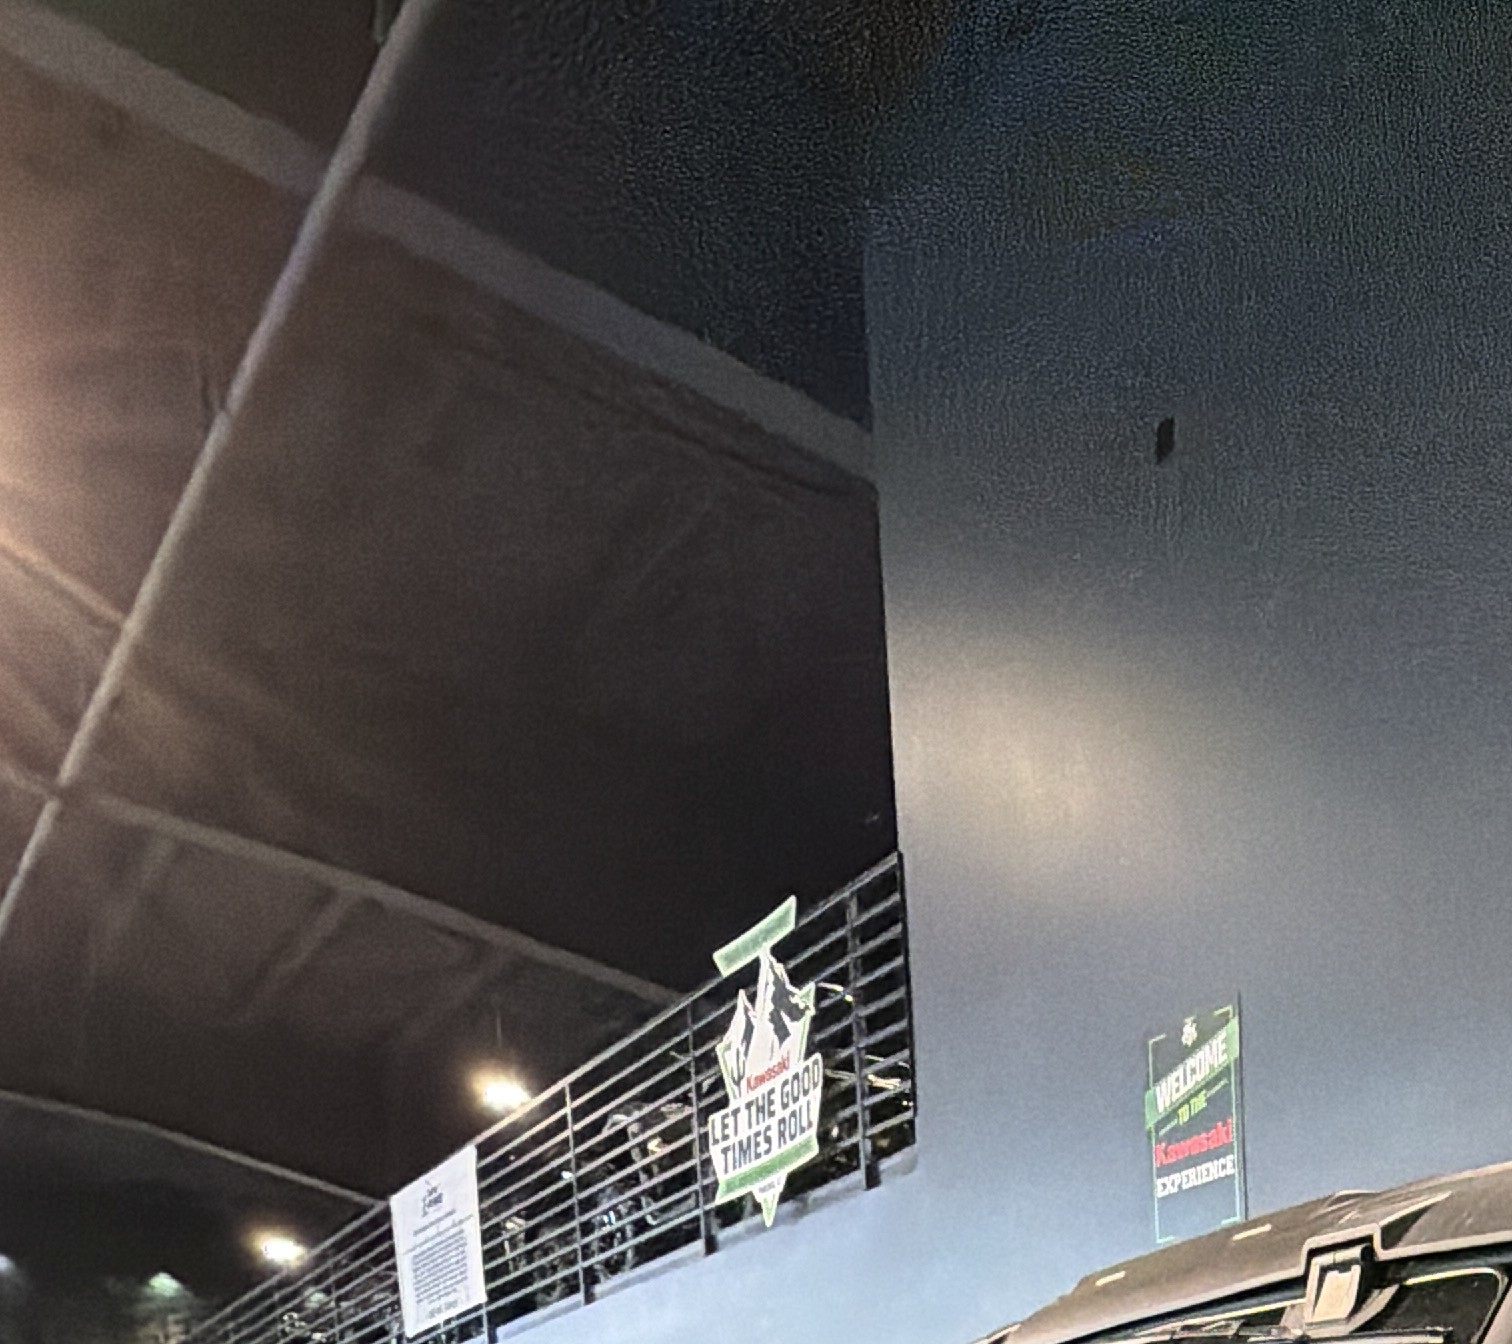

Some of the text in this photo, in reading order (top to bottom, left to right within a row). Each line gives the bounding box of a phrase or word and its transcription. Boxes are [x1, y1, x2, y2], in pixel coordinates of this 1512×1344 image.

[711, 1058, 820, 1146] LET THE GOOD
[1155, 1029, 1228, 1113] WELCOME
[721, 1124, 773, 1174] TIMES
[778, 1099, 813, 1149] ROLL
[1155, 1118, 1234, 1167] Kawasaki
[1177, 1104, 1190, 1125] TO
[1156, 1154, 1236, 1198] EXPERIENCE
